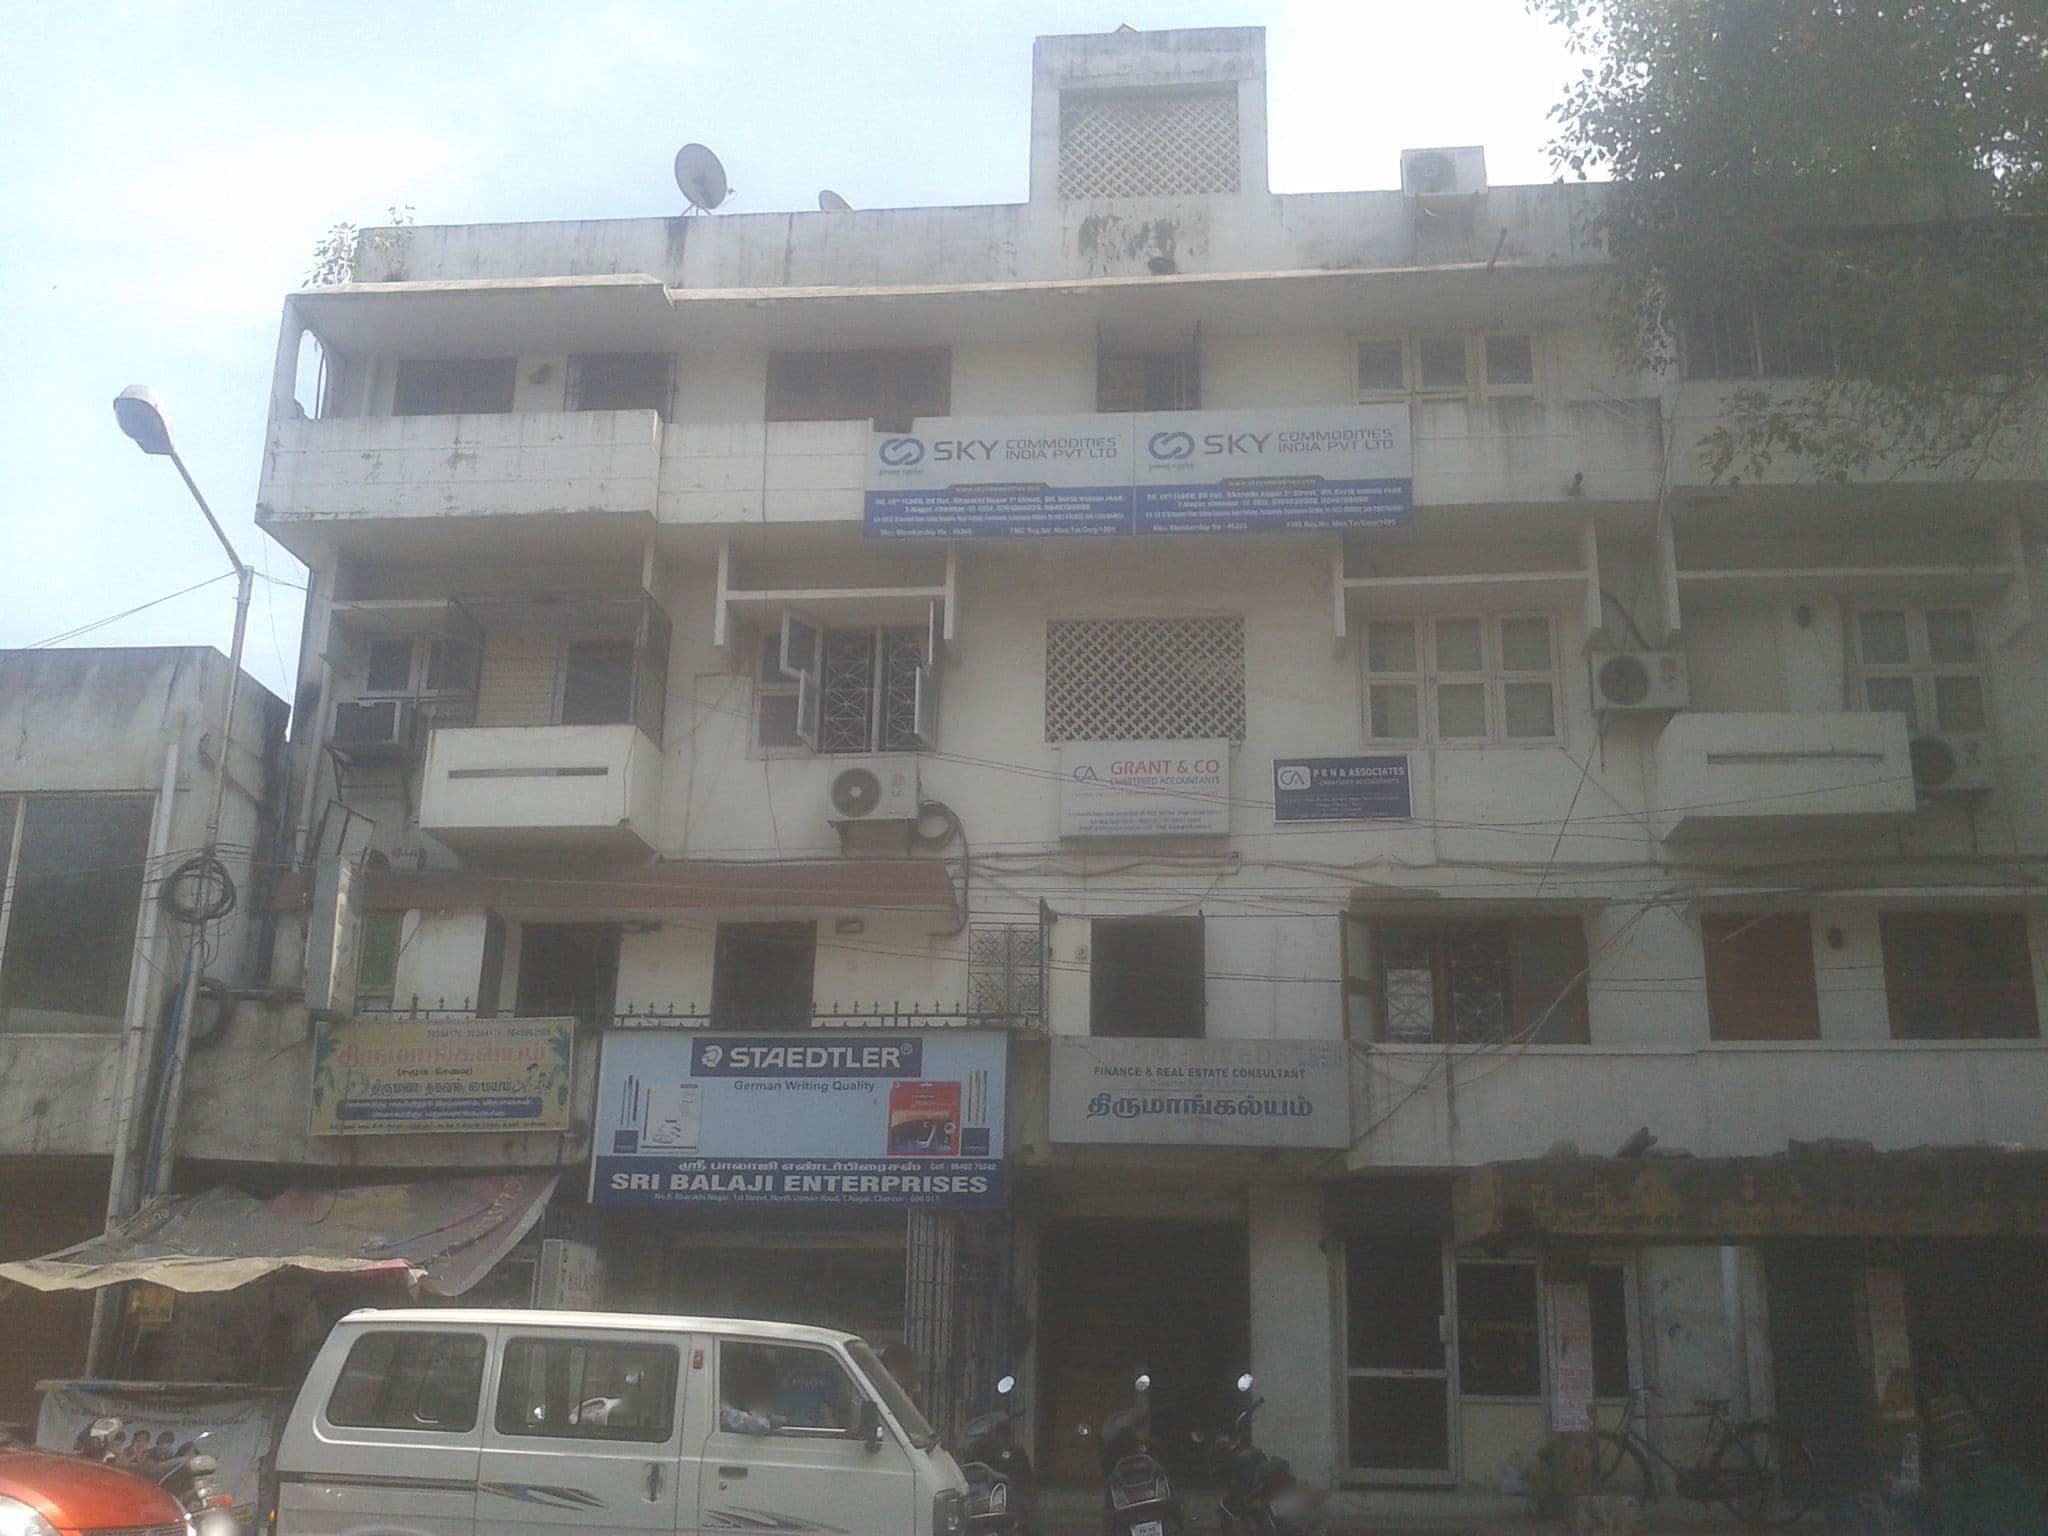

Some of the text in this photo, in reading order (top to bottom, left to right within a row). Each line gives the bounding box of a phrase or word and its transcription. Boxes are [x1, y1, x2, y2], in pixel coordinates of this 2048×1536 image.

[1204, 428, 1393, 455] SKY COMMODITIES
[1277, 439, 1394, 454] INDIA PVT LTD
[933, 437, 1117, 461] SKY COMMODITIES
[1005, 447, 1117, 461] INDIA PVT LTD
[1110, 759, 1220, 776] GRANT & CO
[1349, 766, 1405, 778] ASSOCIATES
[1110, 775, 1221, 787] CHARTERED ACCOUNTANTS
[1094, 1066, 1306, 1080] FINANCE & REAL ESTATE CONSULTANT
[733, 1080, 875, 1094] German Writing Quality
[1086, 1092, 1313, 1119] திருமாங்கல்யம்
[710, 1160, 778, 1171] பாலாஜி
[610, 1172, 989, 1194] SRI BALAJI ENTERPRISES
